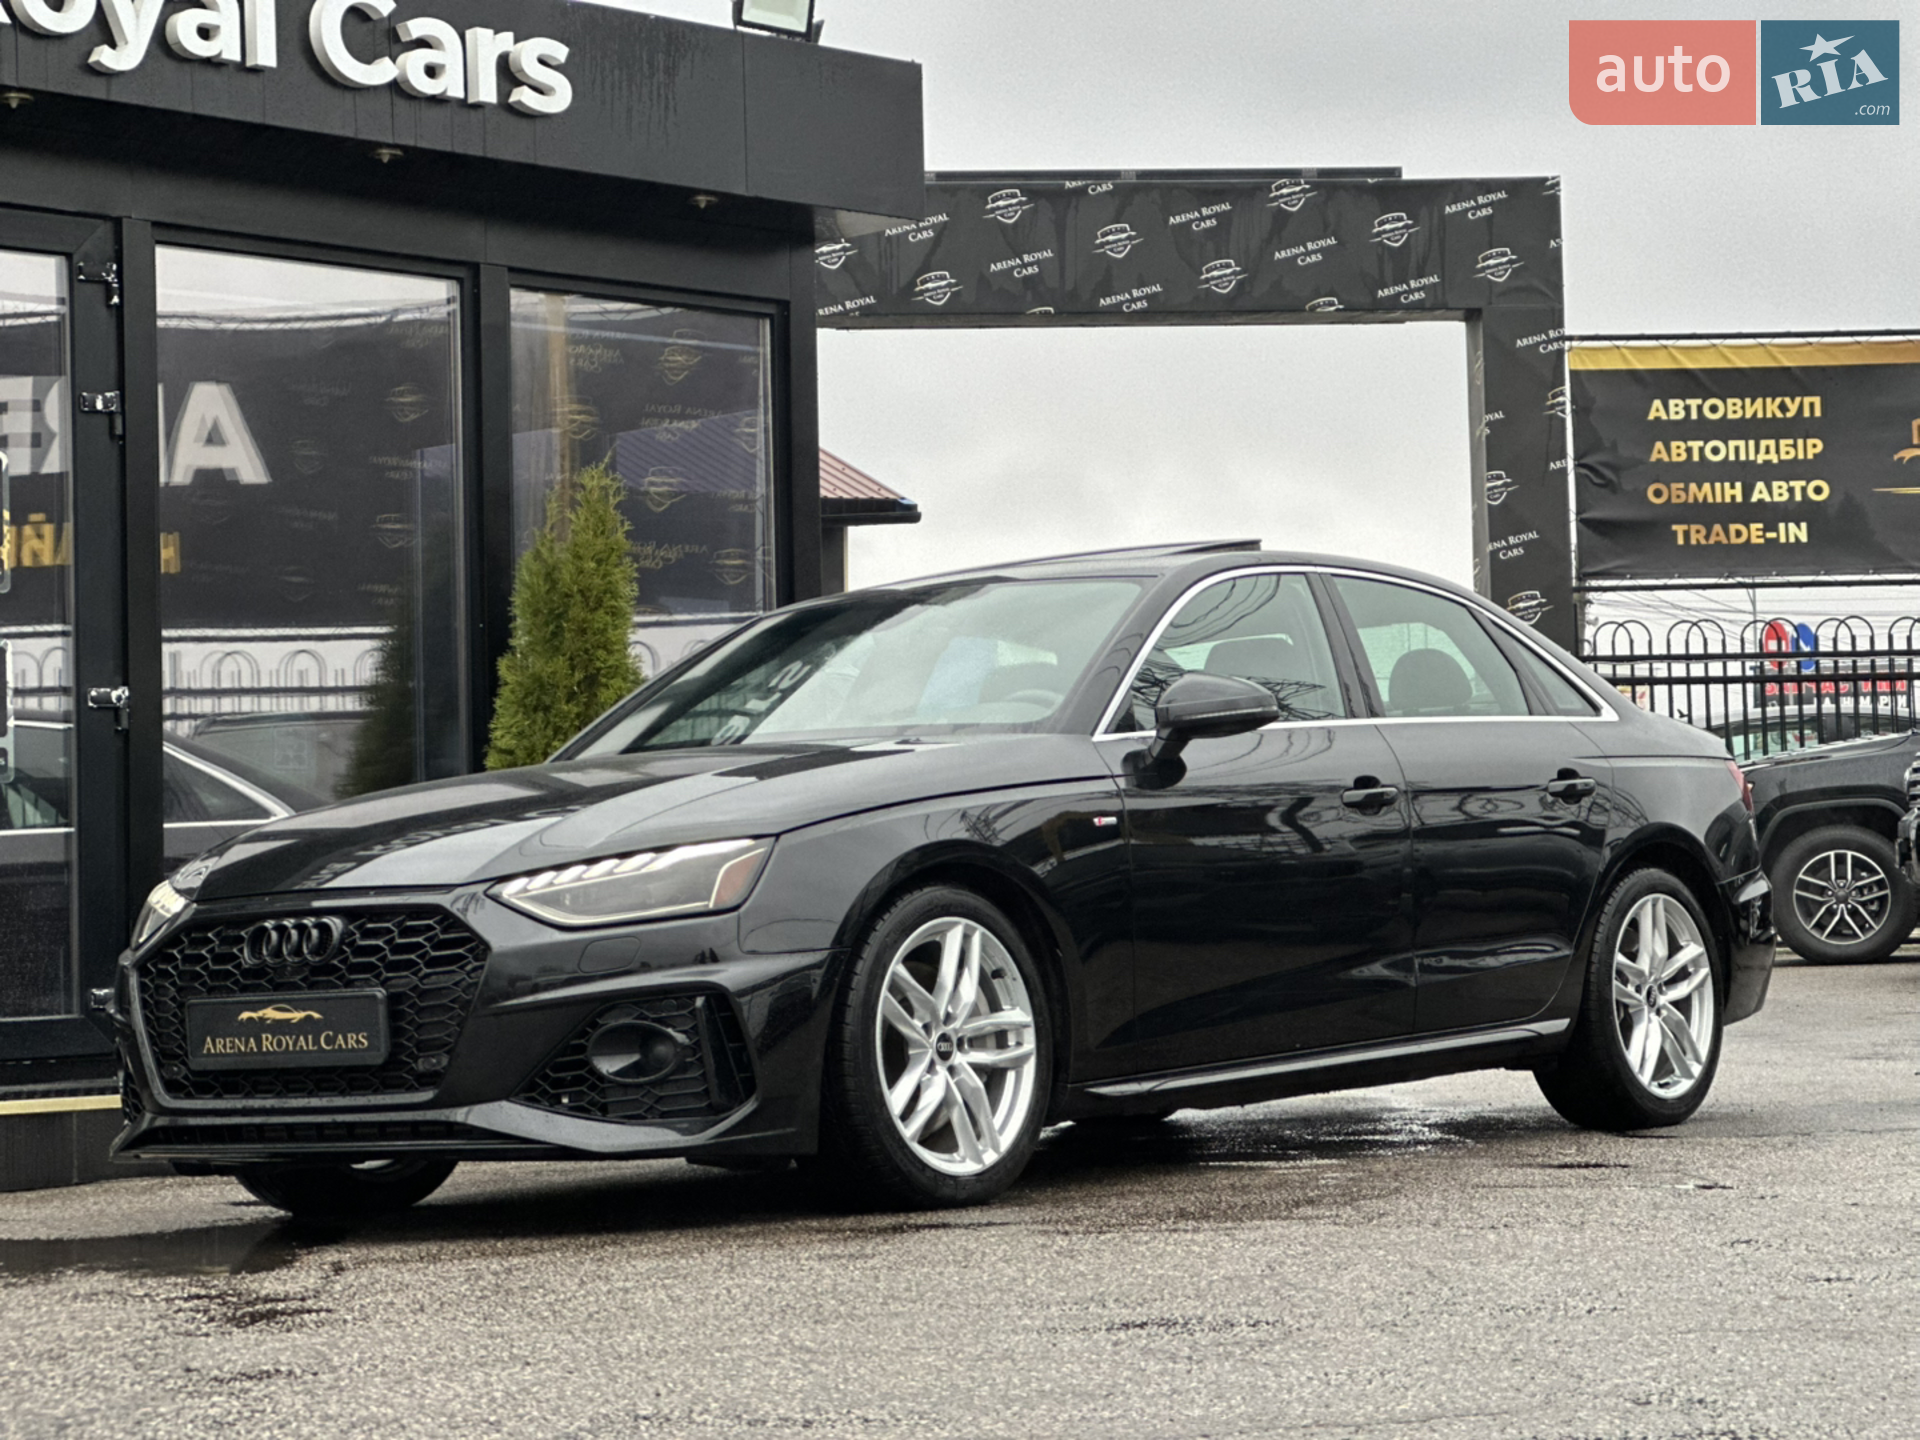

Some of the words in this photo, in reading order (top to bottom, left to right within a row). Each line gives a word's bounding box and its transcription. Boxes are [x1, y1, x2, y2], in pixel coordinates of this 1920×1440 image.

[309, 0, 573, 115] Cars
[1444, 199, 1477, 215] ARENA
[1476, 190, 1509, 205] ROYAL
[1168, 211, 1200, 226] ARENA
[1201, 202, 1233, 216] ROYAL
[1467, 206, 1493, 220] CARS
[1191, 217, 1217, 231] CARS
[908, 228, 934, 242] CARS
[1273, 245, 1306, 260] ARENA
[1306, 236, 1339, 252] ROYAL
[989, 257, 1022, 272] ARENA
[1022, 248, 1055, 264] ROYAL
[1296, 252, 1323, 266] CARS
[1013, 264, 1039, 278] CARS
[1099, 292, 1131, 307] ARENA
[1131, 283, 1163, 298] ROYAL
[1377, 283, 1409, 299] ARENA
[1409, 274, 1441, 289] ROYAL
[844, 295, 877, 310] ROYAL
[1122, 299, 1148, 313] CARS
[1400, 290, 1426, 304] CARS
[1515, 333, 1548, 348] ARENA
[1539, 340, 1565, 354] CARS
[1646, 396, 1823, 421] АВТОВИКУП
[1648, 438, 1824, 464] АВТОПІДБІР
[1646, 482, 1743, 505] ОБМІН
[1750, 479, 1830, 503] АВТО
[1507, 530, 1540, 545] ROYAL
[1671, 522, 1808, 546] TRADE-IN
[1499, 546, 1525, 560] CARS
[203, 1035, 258, 1055] ARENA
[260, 1032, 318, 1052] ROYAL
[319, 1030, 369, 1050] CARS
